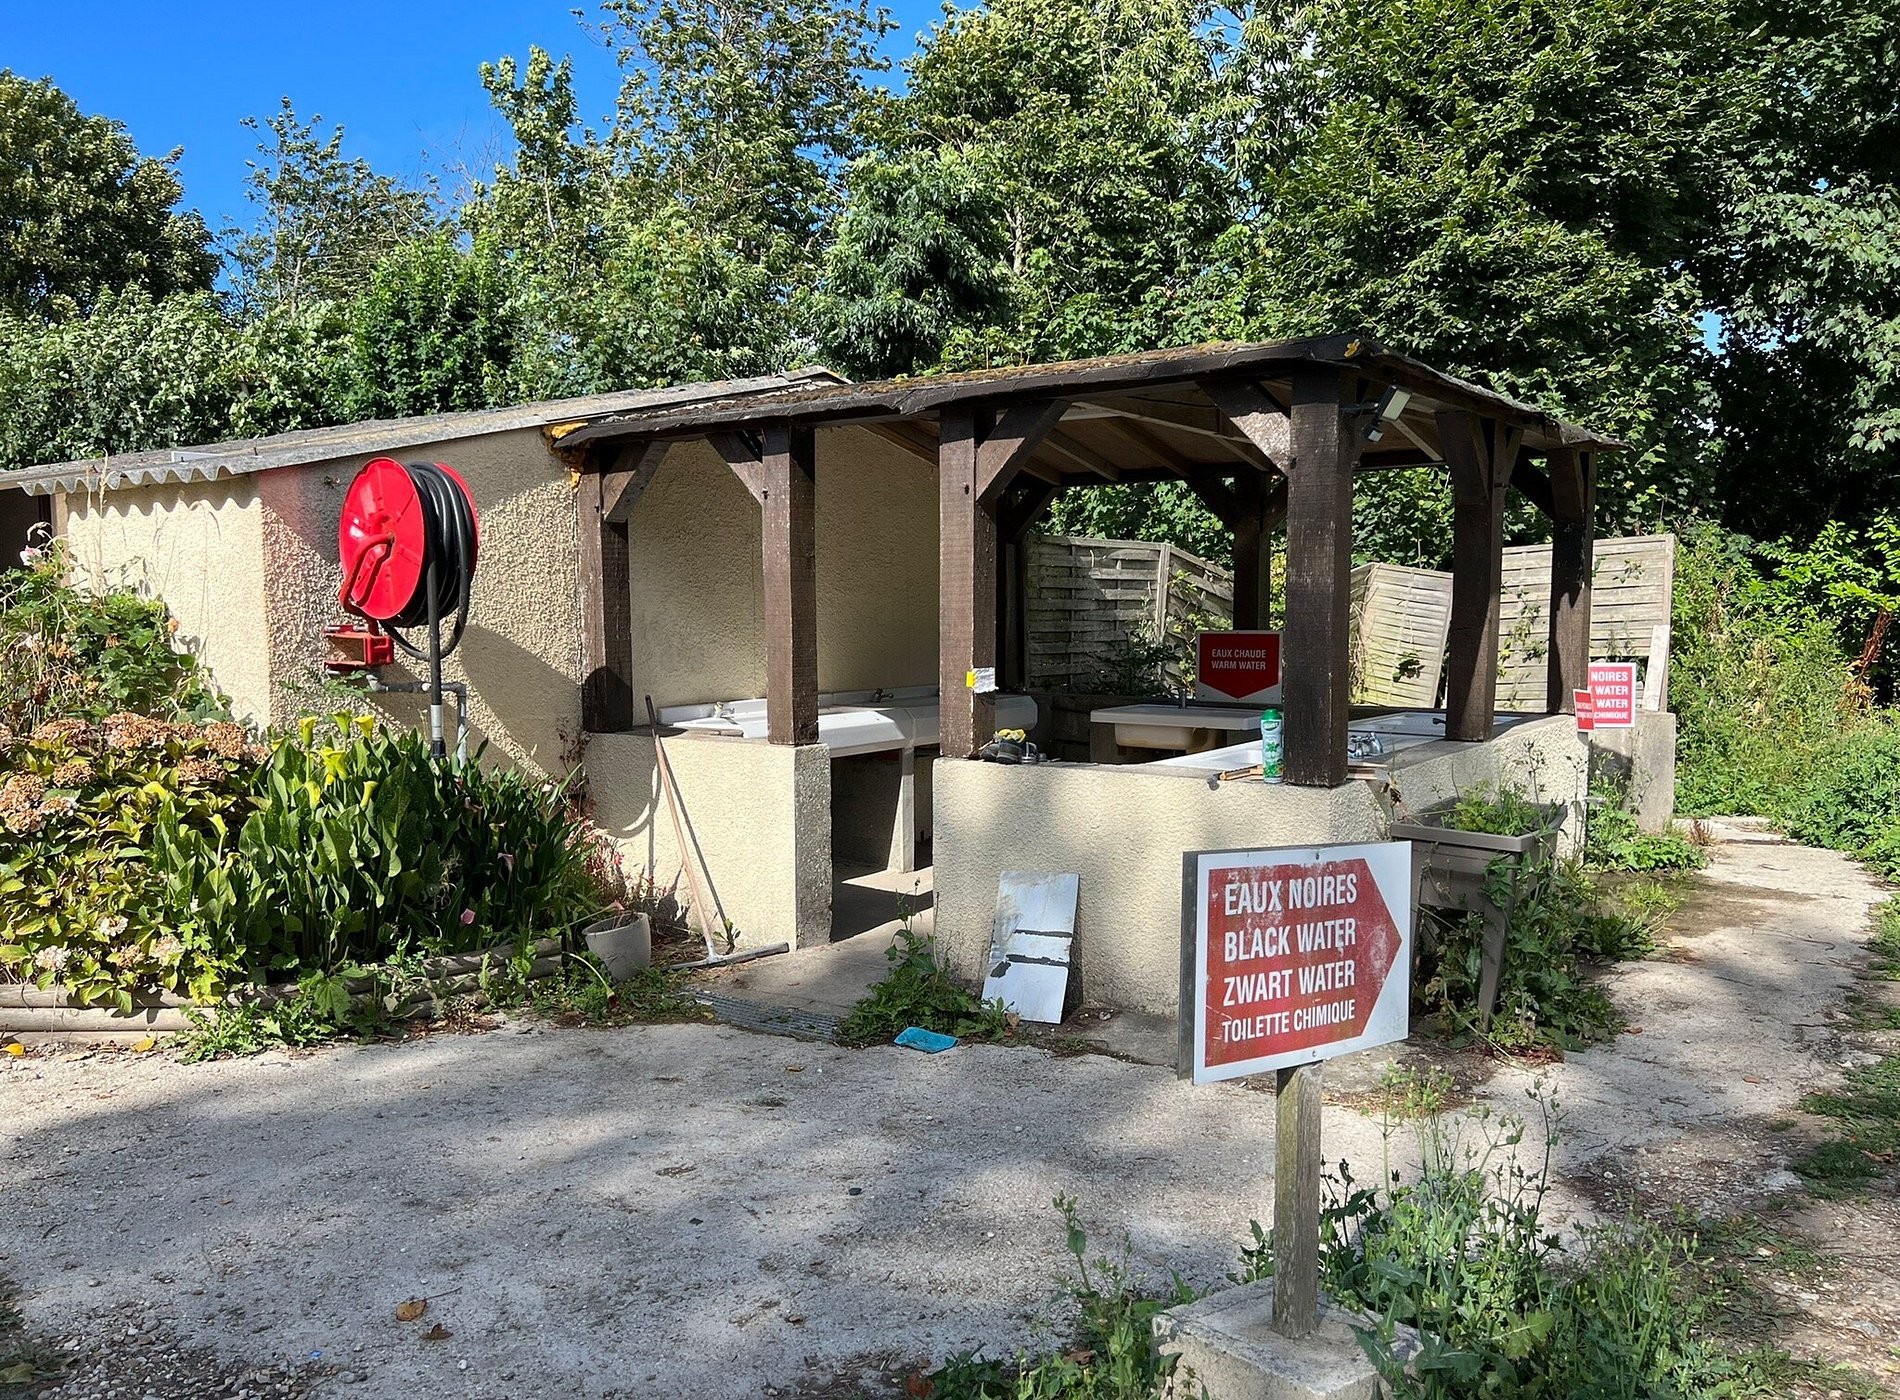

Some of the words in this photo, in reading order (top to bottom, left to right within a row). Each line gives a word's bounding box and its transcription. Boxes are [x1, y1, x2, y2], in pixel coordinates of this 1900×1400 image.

[1212, 648, 1232, 658] EAUX
[1234, 649, 1266, 658] CHAUDE
[1212, 661, 1236, 669] WARM
[1239, 661, 1266, 670] WATER
[1591, 672, 1628, 682] NOIRES
[1595, 685, 1628, 695] WATER
[1596, 699, 1628, 708] WATER
[1224, 880, 1282, 916] EAUX
[1288, 873, 1357, 910] NOIRES
[1224, 926, 1290, 962] BLACK
[1297, 918, 1356, 953] WATER
[1223, 969, 1293, 1007] ZWART
[1298, 960, 1355, 995] WATER
[1222, 1011, 1289, 1043] TOILETTE
[1294, 999, 1355, 1032] CHIMIQUE
